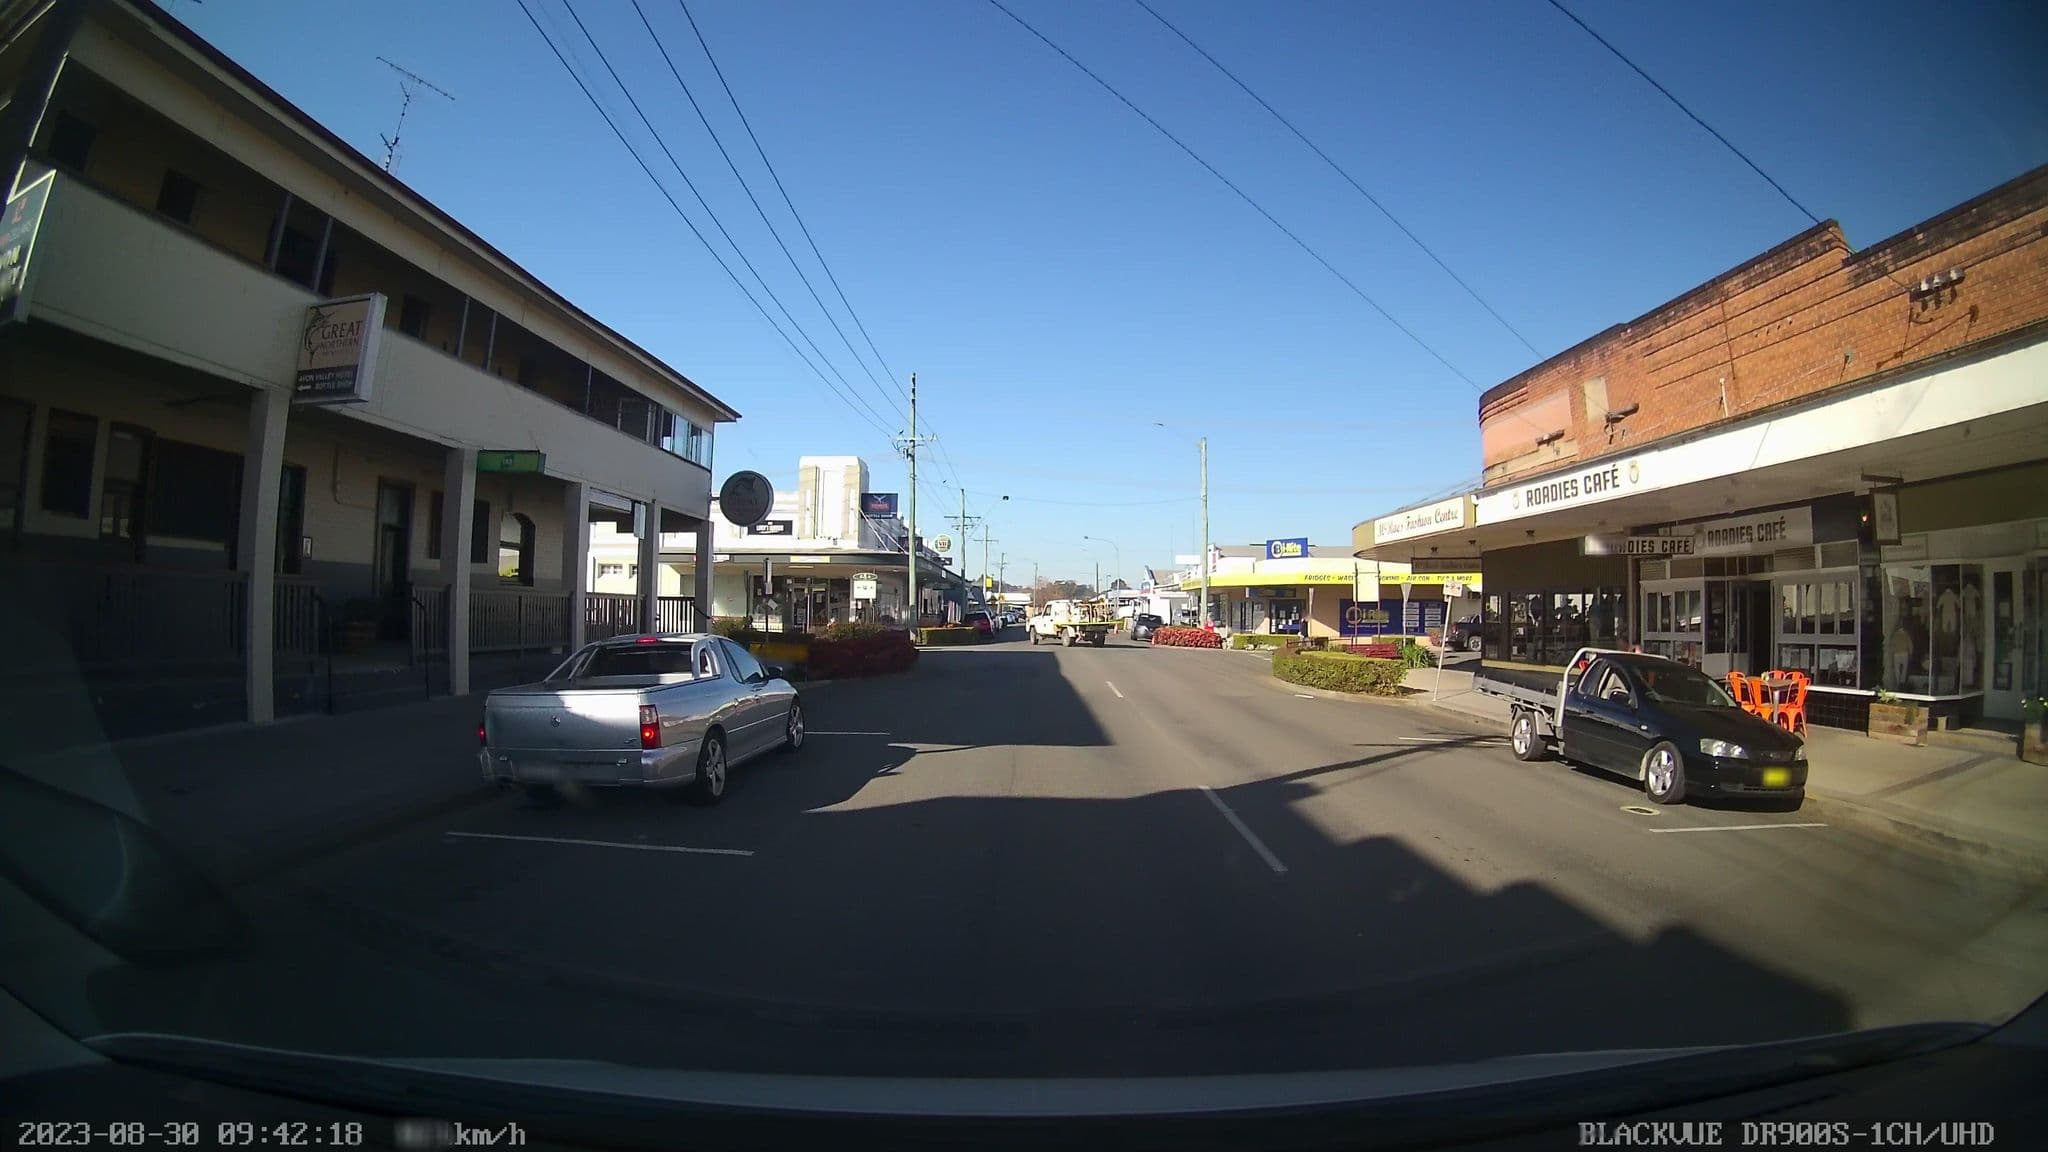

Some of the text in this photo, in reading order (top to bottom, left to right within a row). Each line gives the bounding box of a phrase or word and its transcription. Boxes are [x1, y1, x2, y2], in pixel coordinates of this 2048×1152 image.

[321, 320, 363, 340] GREAT
[1526, 464, 1620, 508] ROADIES CAFÉ
[1434, 508, 1458, 524] Centre
[1707, 515, 1788, 548] ROADIES CAFÉ
[1304, 574, 1331, 582] FRIDGES
